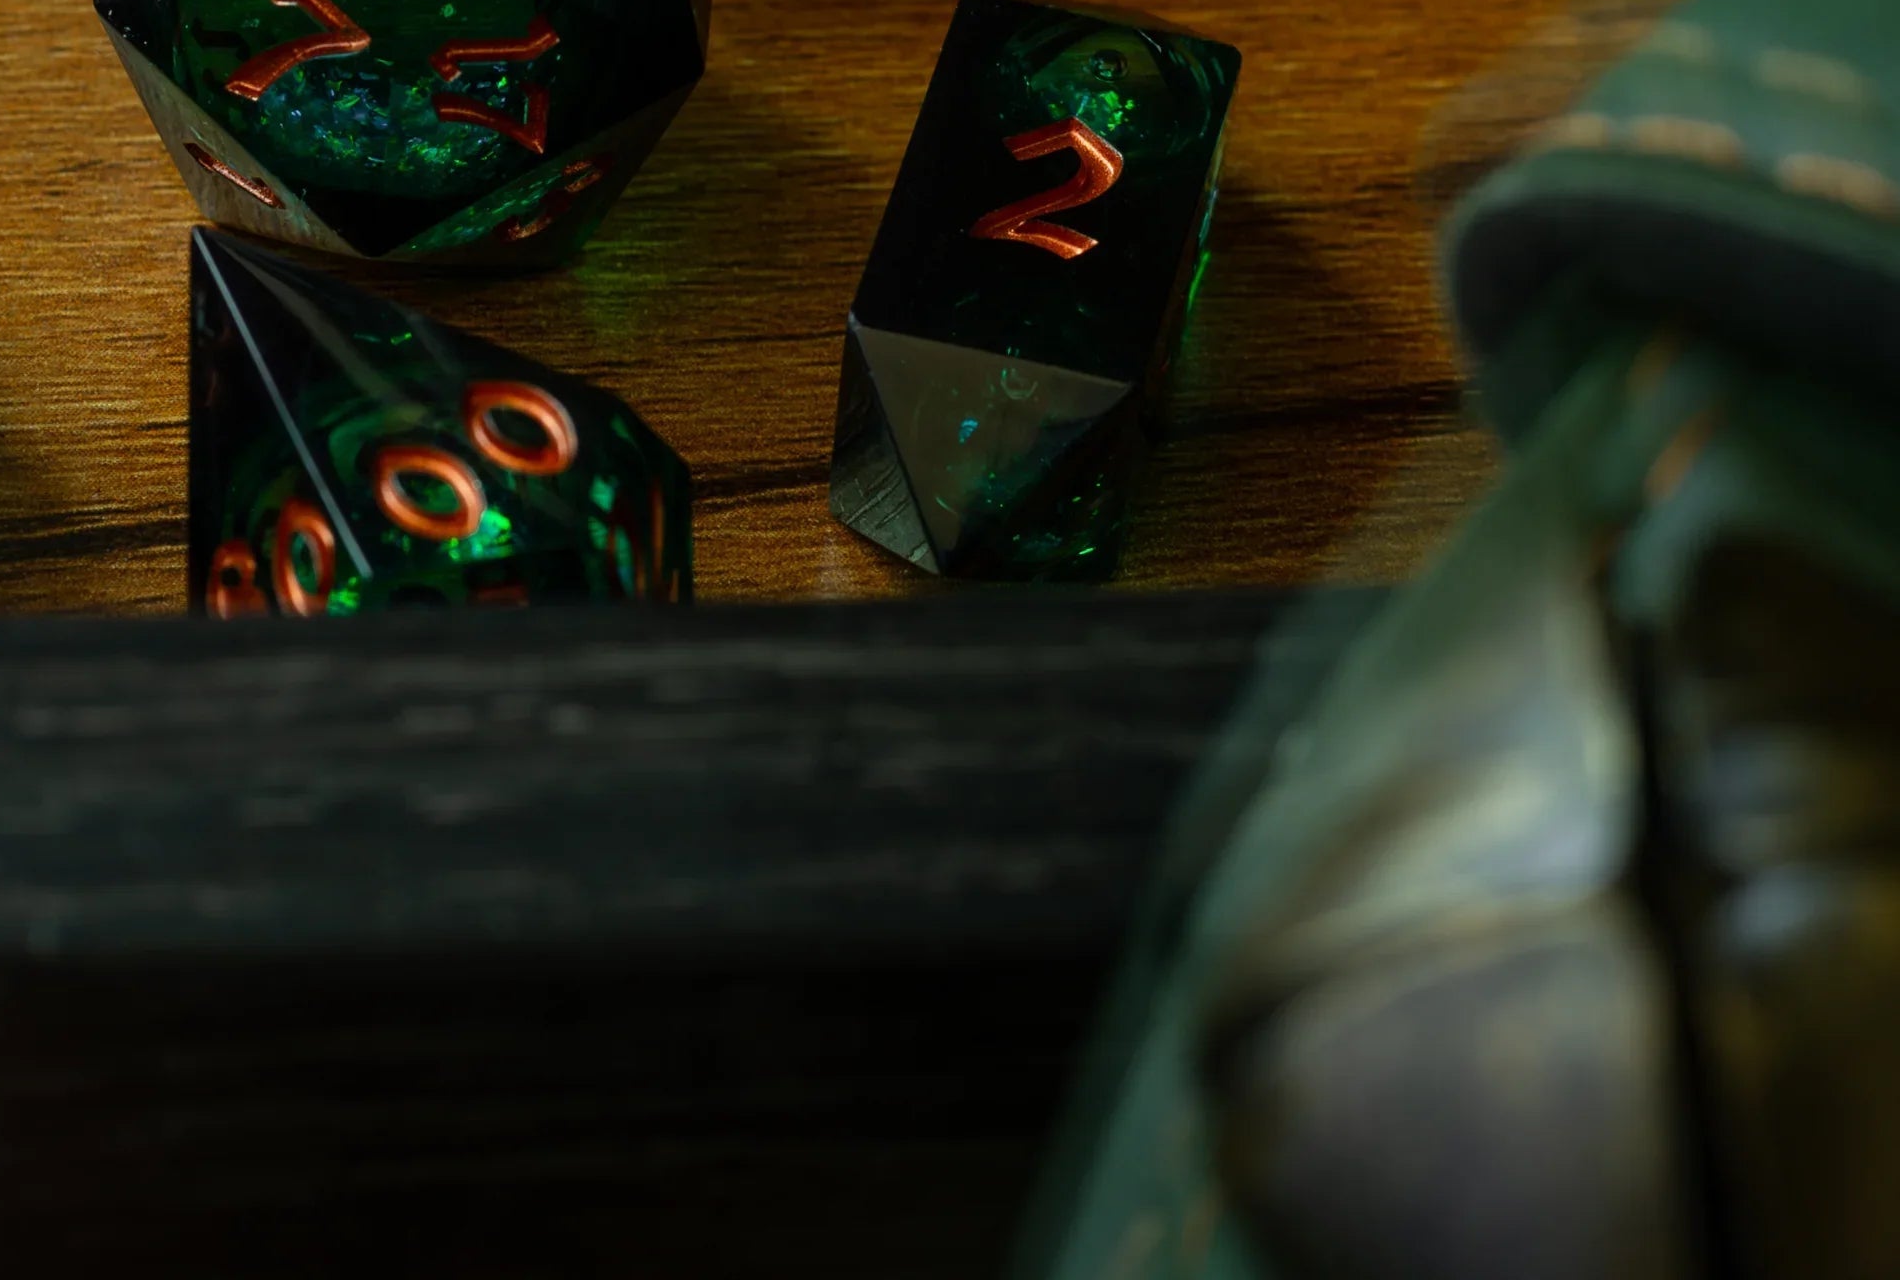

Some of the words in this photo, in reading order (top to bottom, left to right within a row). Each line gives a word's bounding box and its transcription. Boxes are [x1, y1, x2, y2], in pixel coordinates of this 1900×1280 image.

[430, 14, 561, 155] 17
[968, 115, 1125, 261] 2
[373, 378, 581, 542] 00
